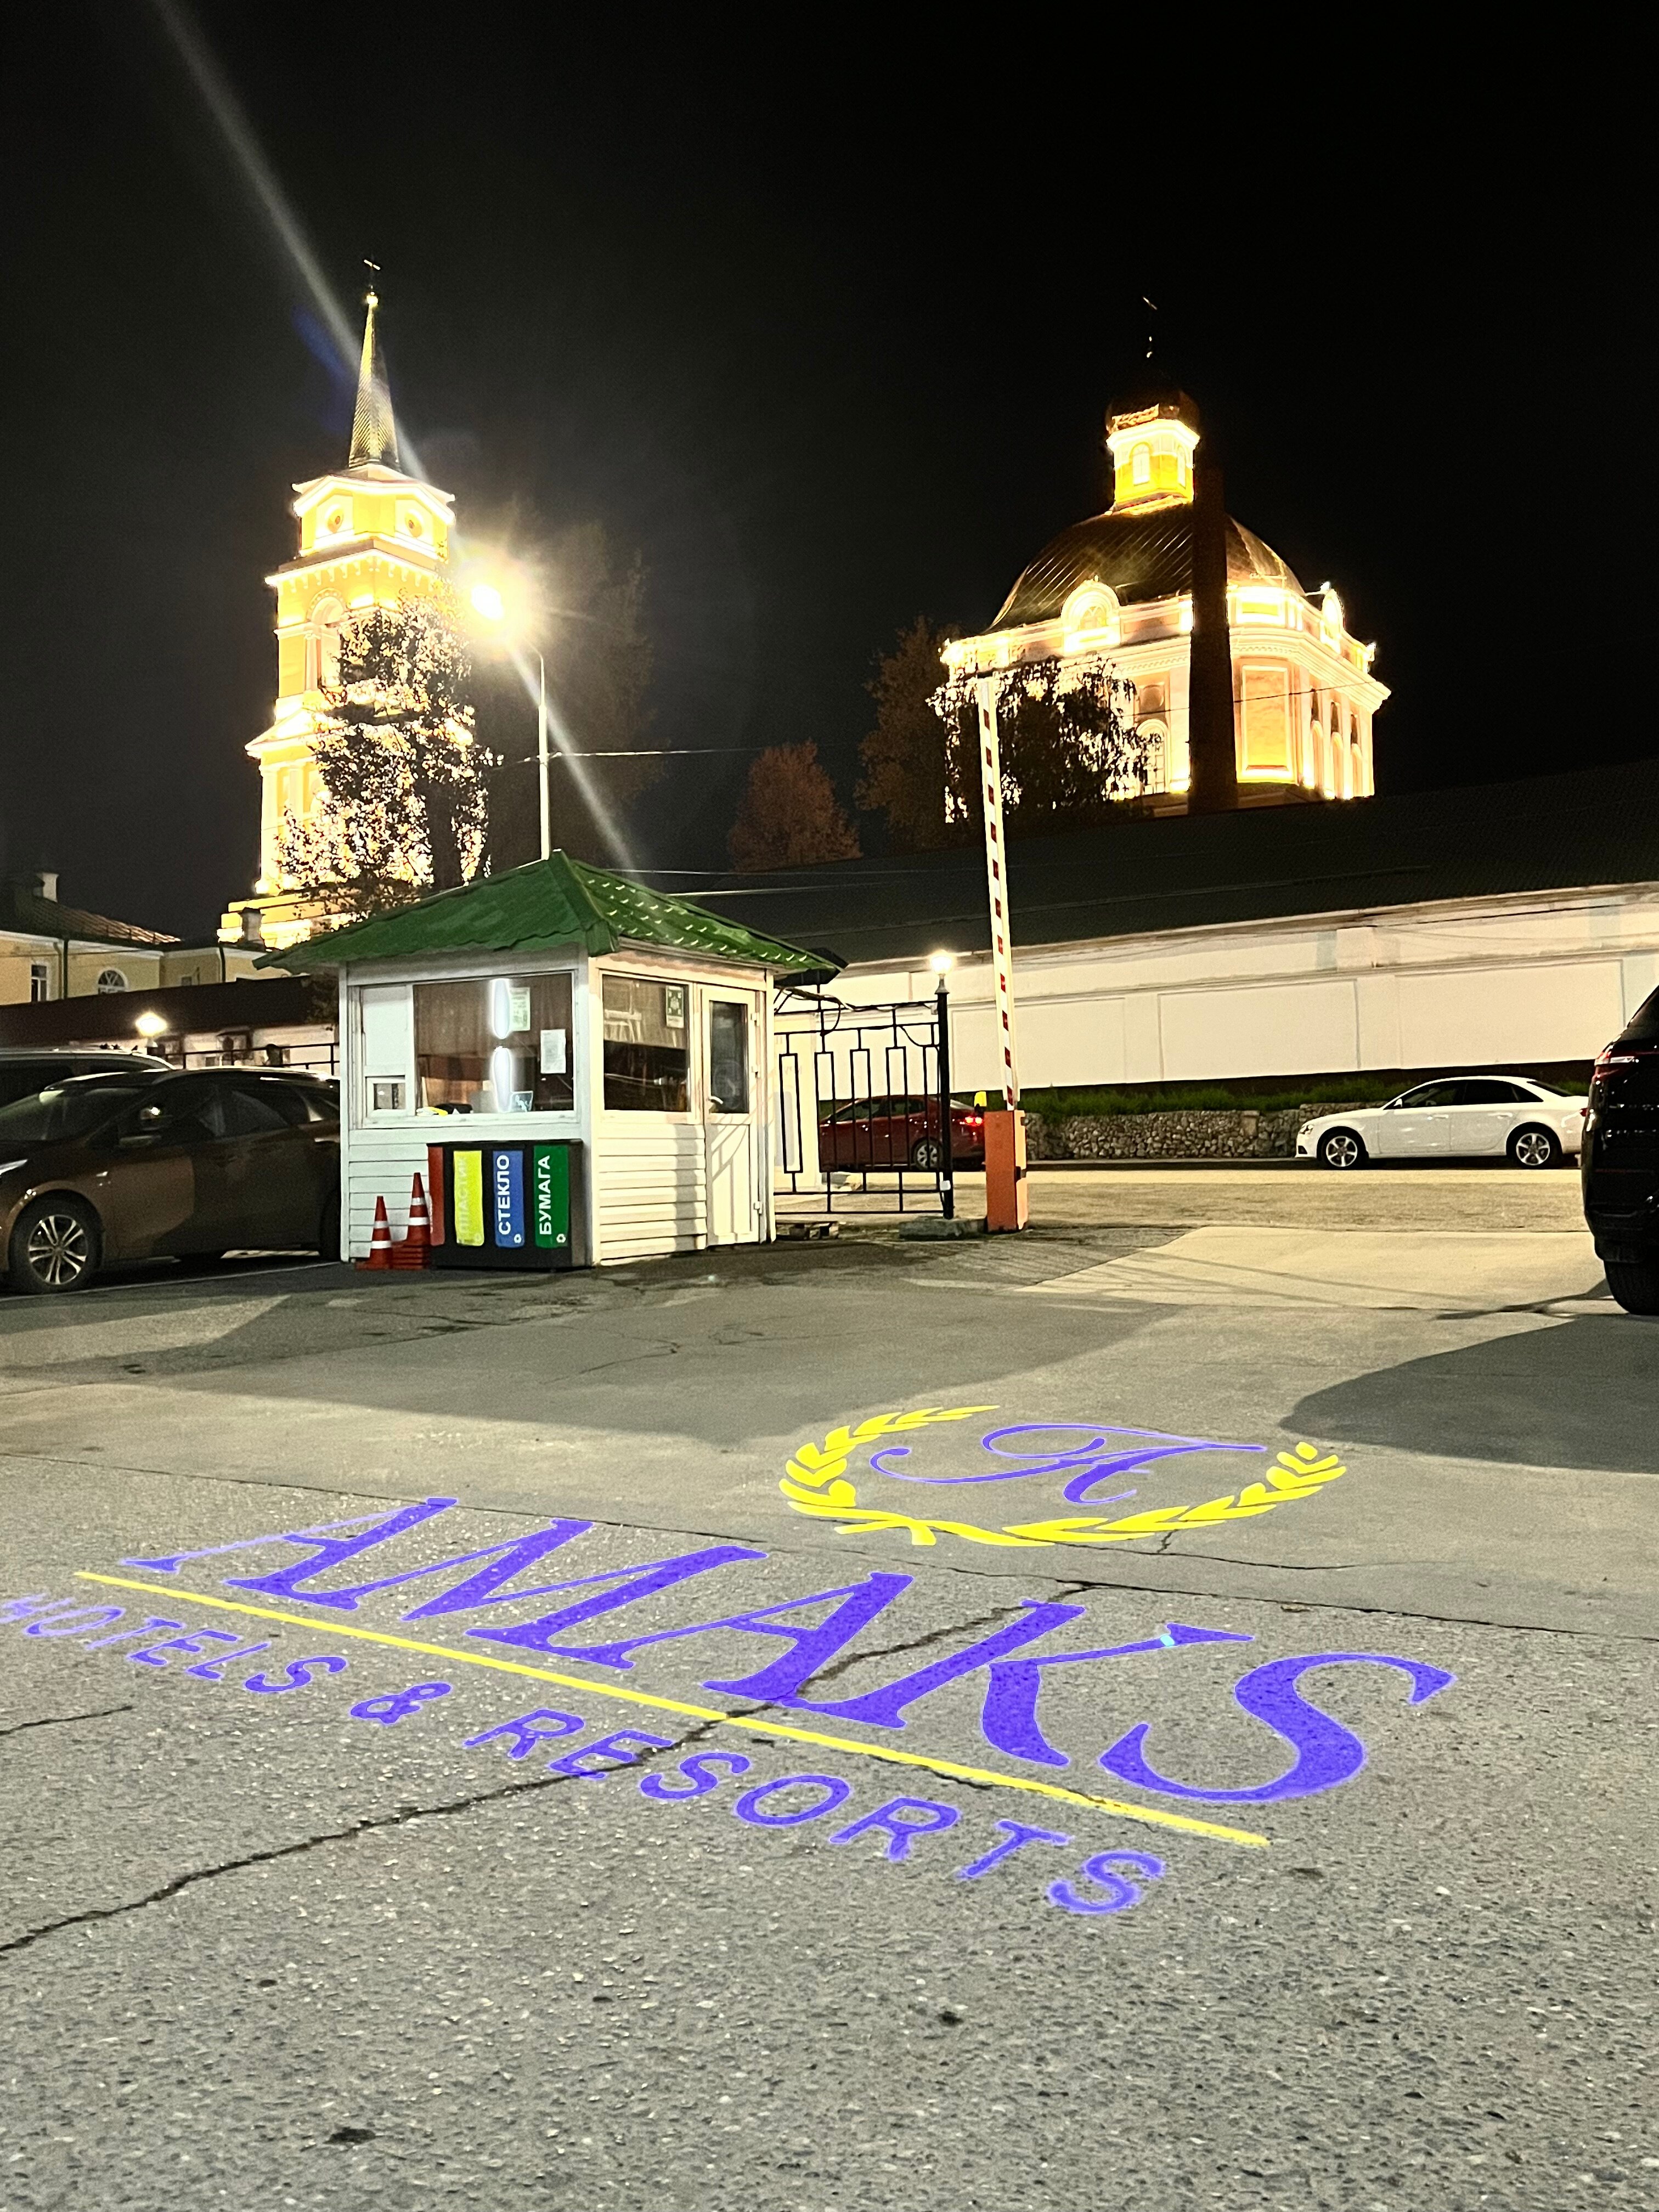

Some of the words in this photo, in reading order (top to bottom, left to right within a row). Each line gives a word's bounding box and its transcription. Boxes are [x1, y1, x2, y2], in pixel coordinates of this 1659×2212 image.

[496, 1154, 511, 1235] СТЕКЛО
[538, 1155, 552, 1235] БУМАГА
[119, 1497, 1457, 1804] AMAKS
[0, 1593, 348, 1694] HOTELS
[348, 1681, 454, 1726] &
[462, 1707, 1167, 1915] RESORTS
